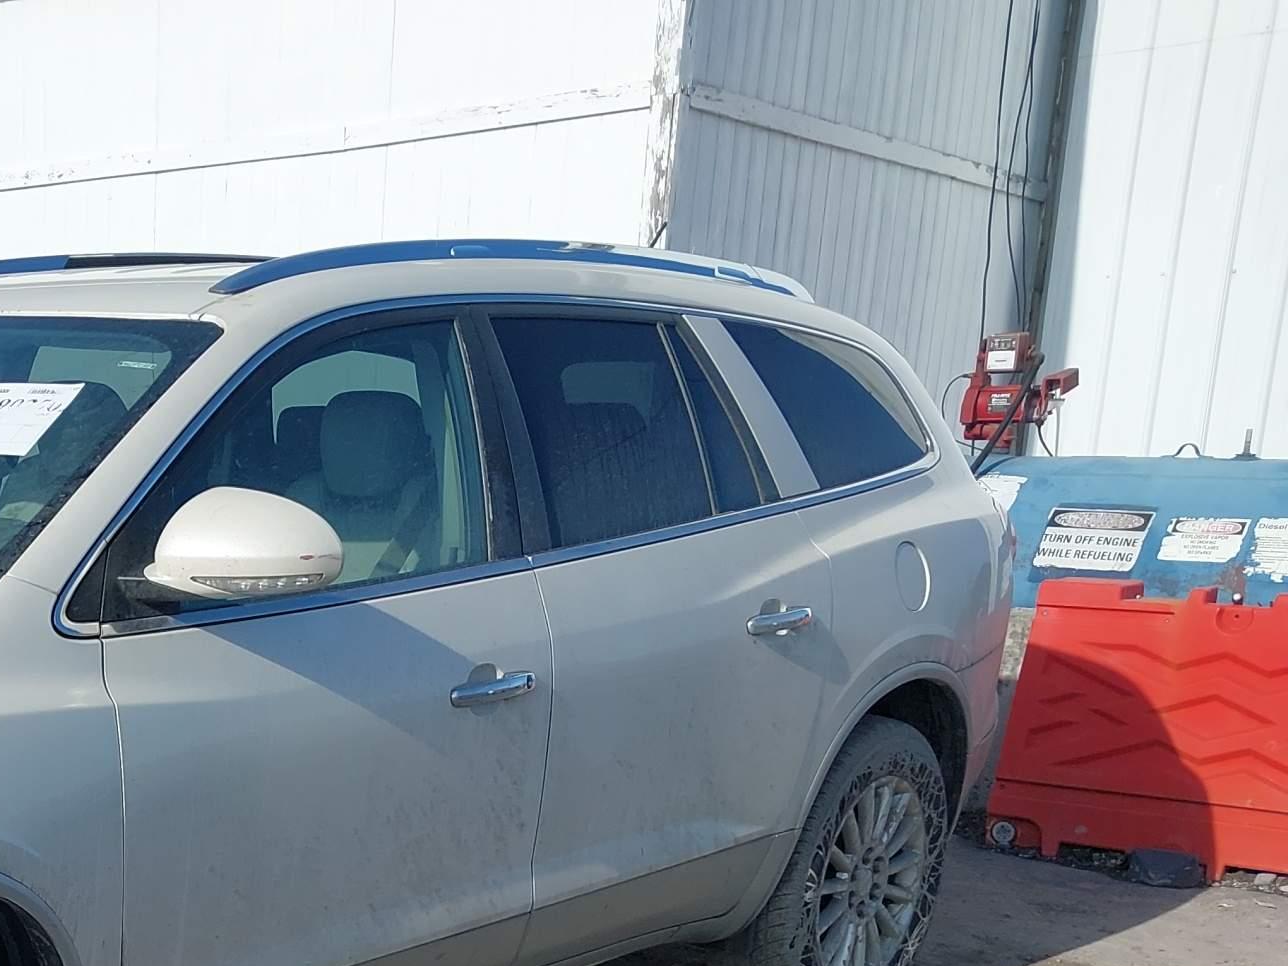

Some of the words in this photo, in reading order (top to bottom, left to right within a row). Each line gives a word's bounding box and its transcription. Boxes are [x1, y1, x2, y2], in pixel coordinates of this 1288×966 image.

[1179, 523, 1233, 533] ANGER
[1043, 533, 1073, 543] TURN
[1075, 535, 1095, 544] OFF
[1097, 536, 1139, 547] ENGINE
[1037, 548, 1073, 559] WHILE
[1073, 549, 1133, 562] REFUELING
